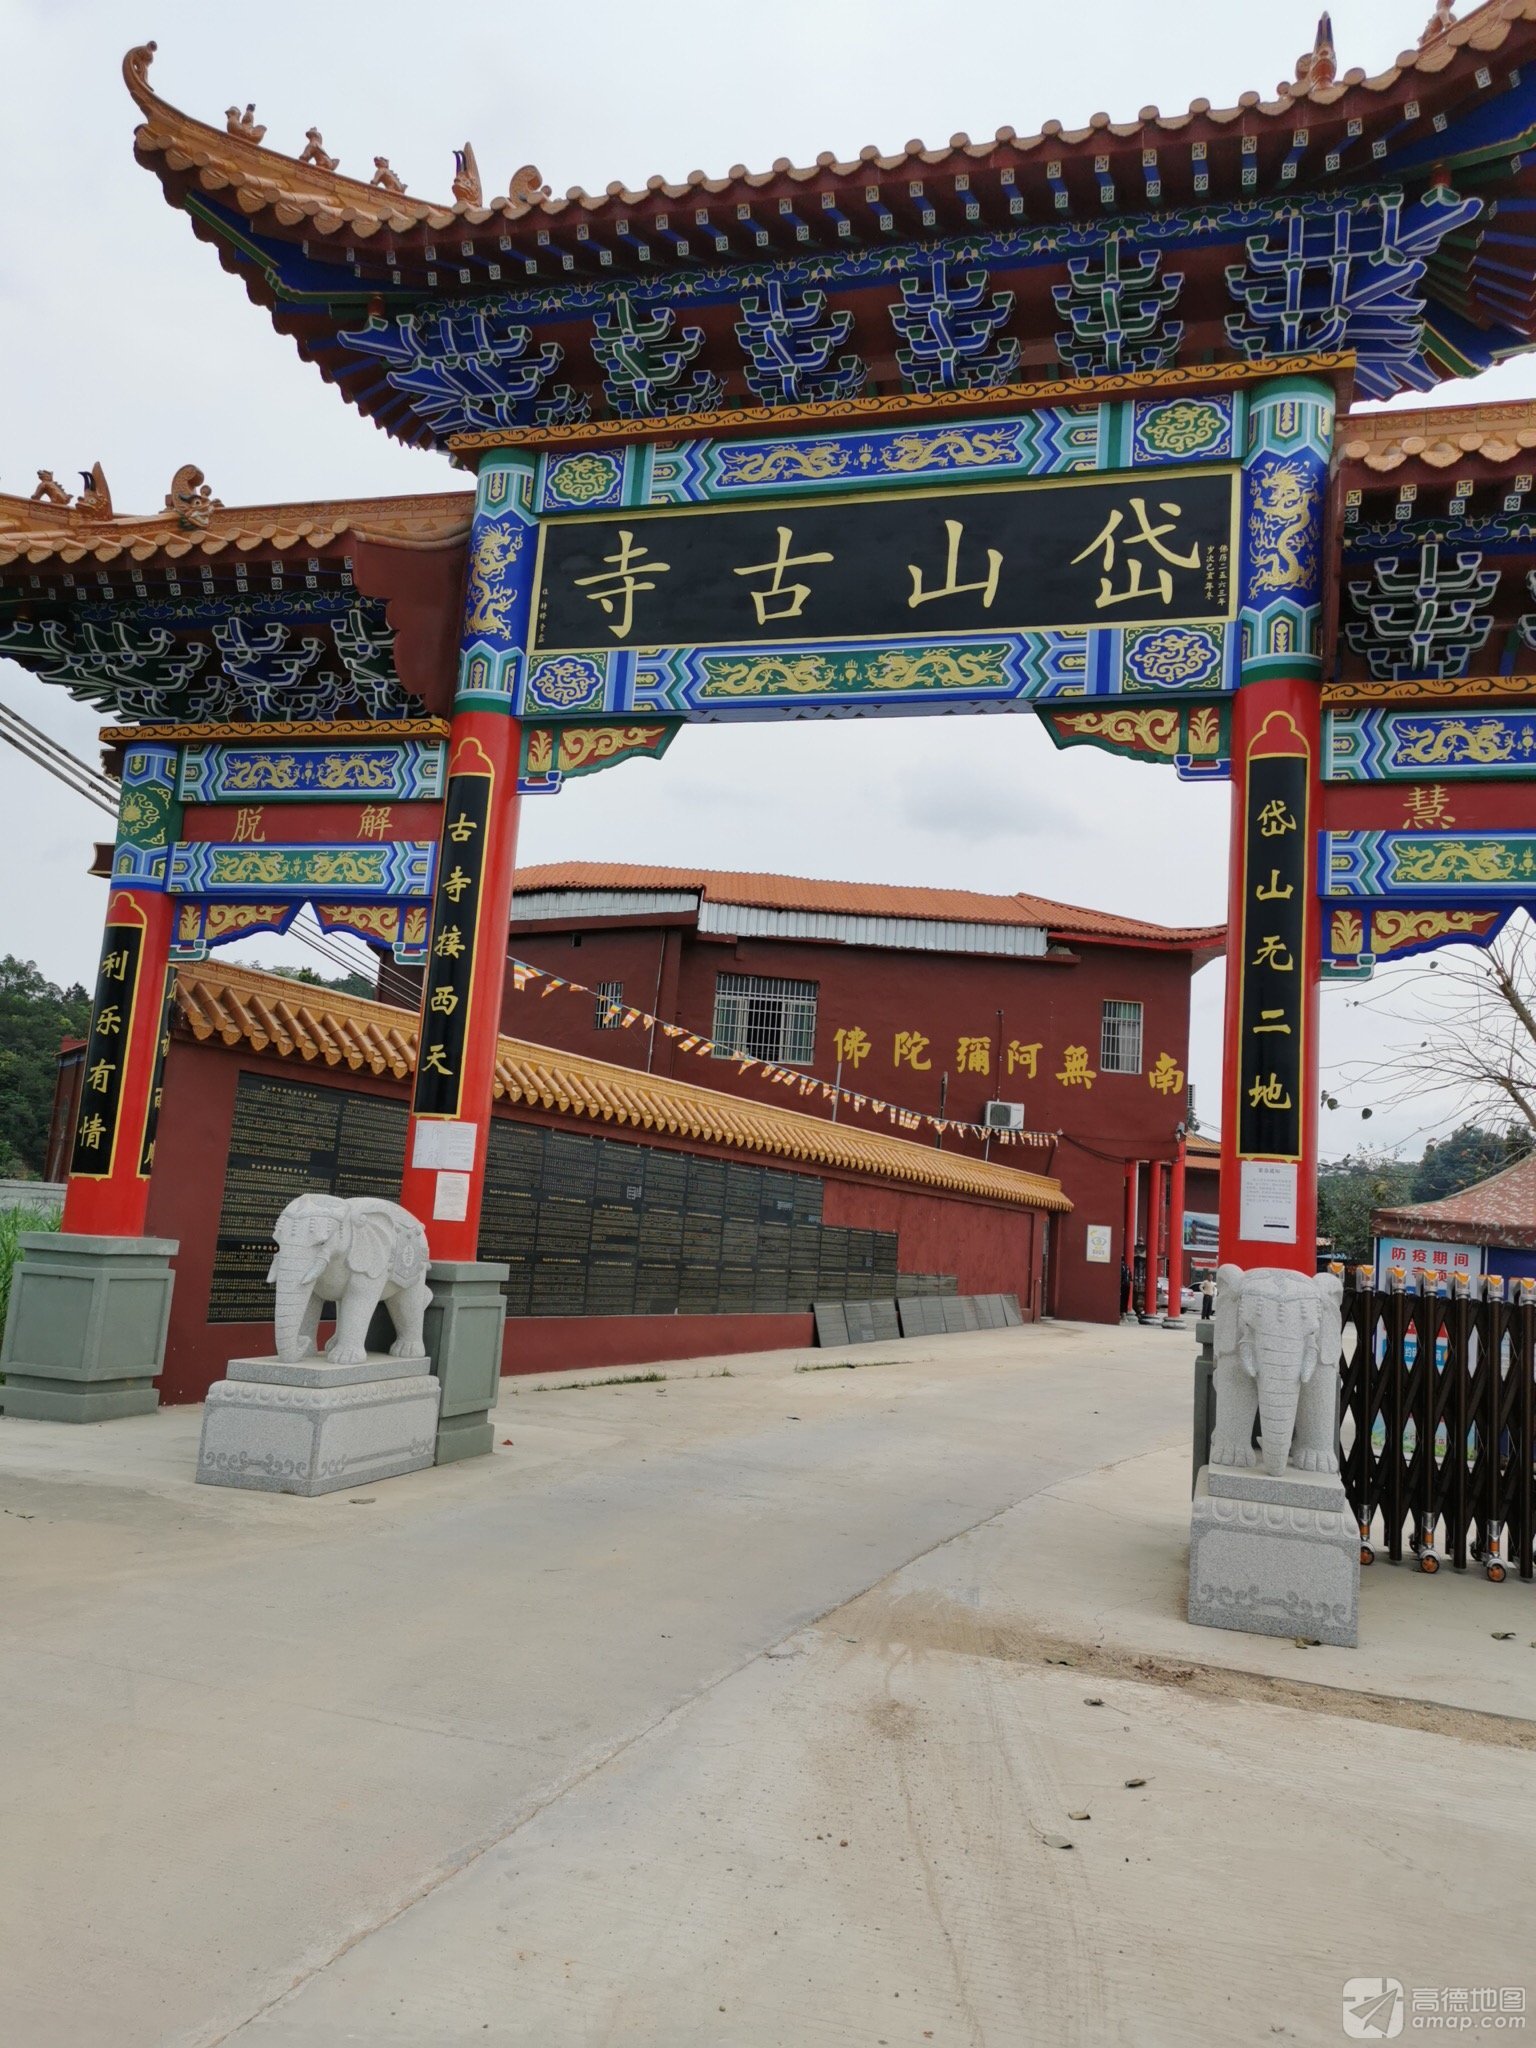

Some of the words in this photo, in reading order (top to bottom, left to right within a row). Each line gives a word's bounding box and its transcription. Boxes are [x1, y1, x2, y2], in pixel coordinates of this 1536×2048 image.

[573, 497, 1200, 639] 岱山古寺
[1402, 784, 1456, 829] 慧
[421, 812, 477, 1075] 古寺接西天
[79, 950, 129, 1149] 利乐有情
[1391, 1246, 1470, 1268] 防疫期间
